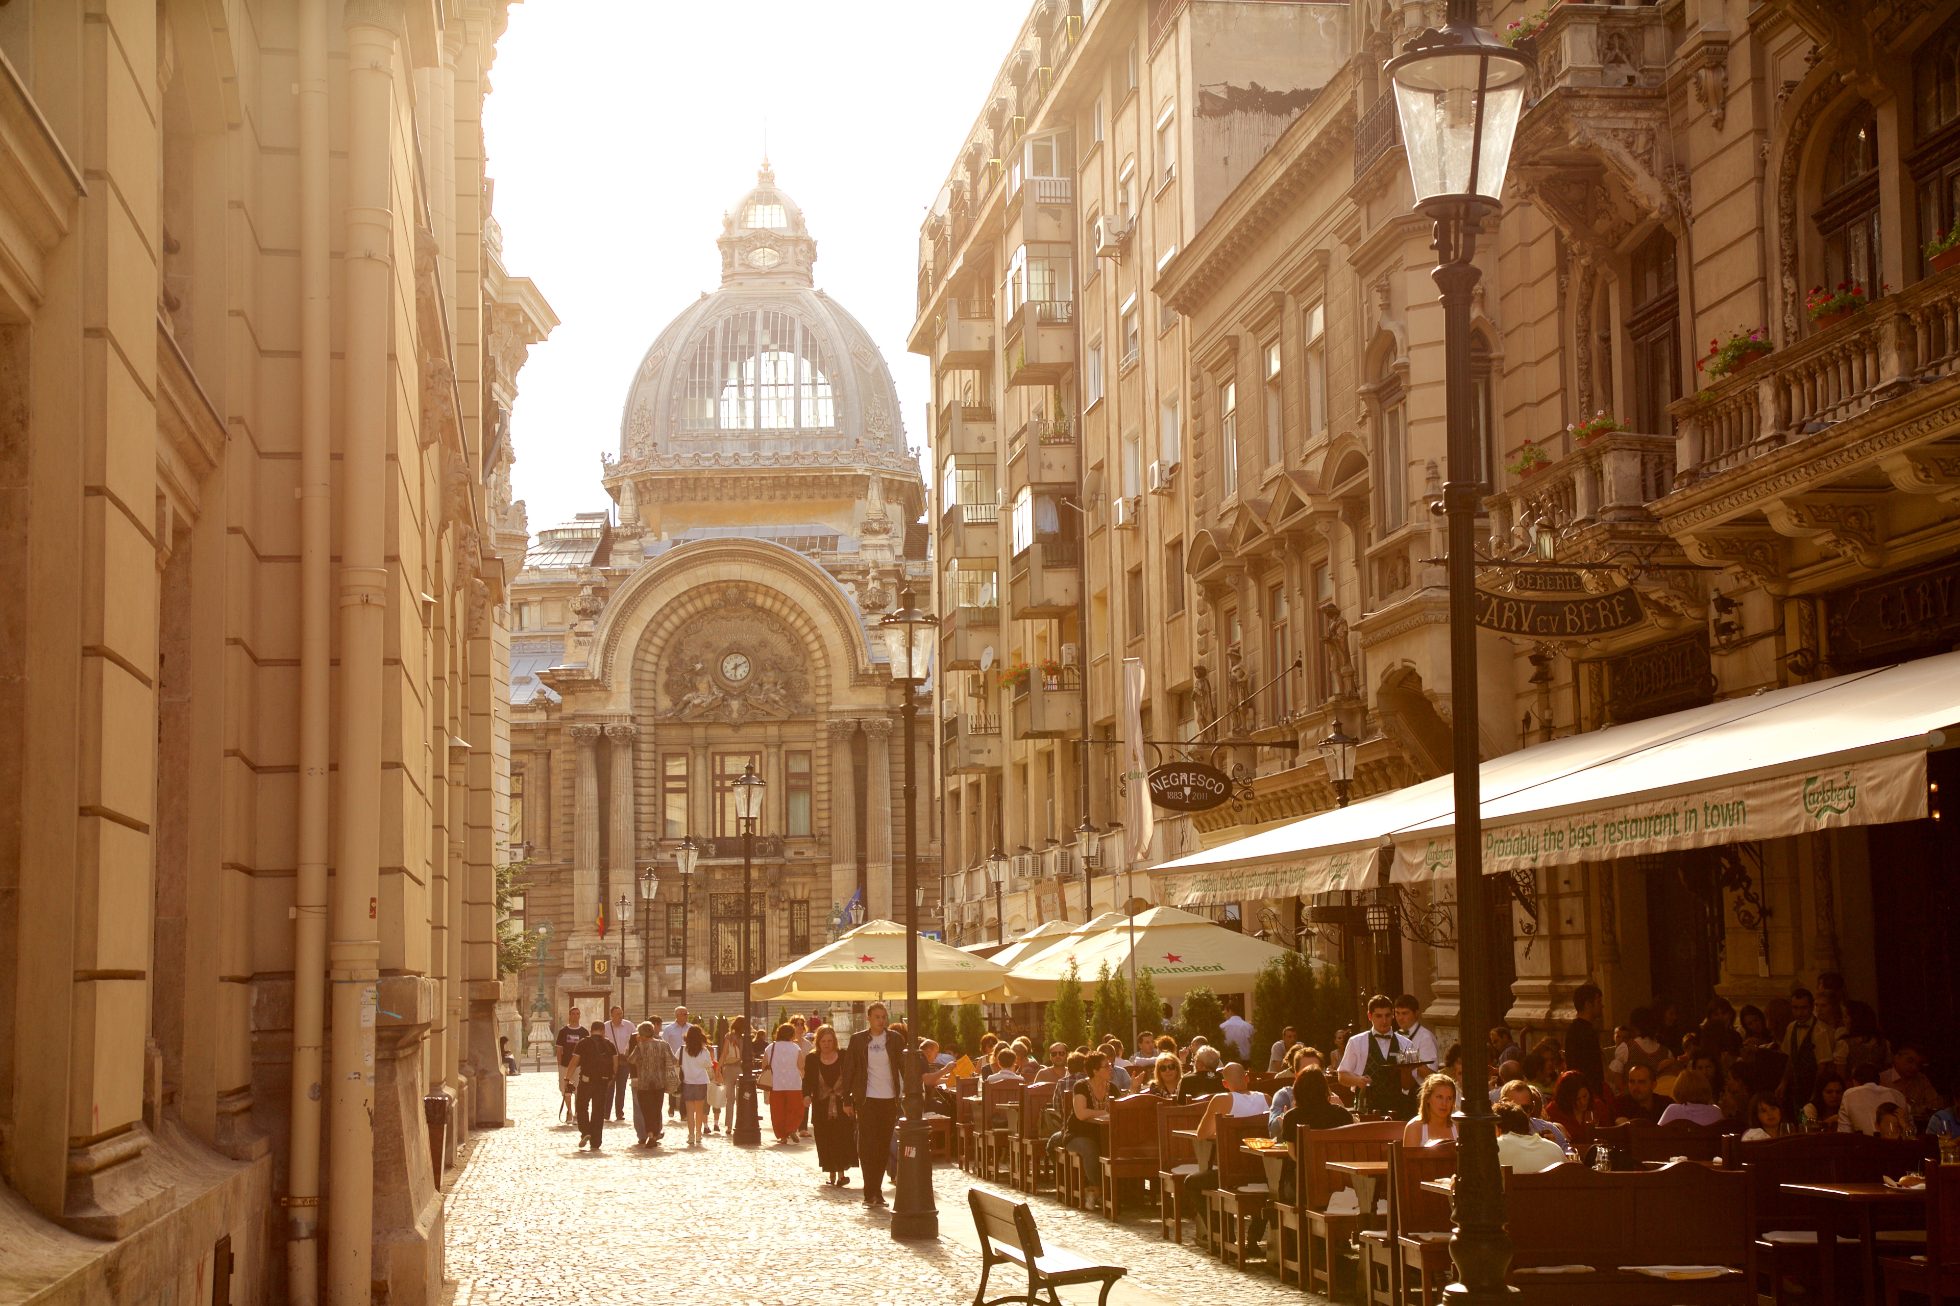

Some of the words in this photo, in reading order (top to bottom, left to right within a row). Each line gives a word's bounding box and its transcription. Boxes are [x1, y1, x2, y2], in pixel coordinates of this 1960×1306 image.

[1564, 596, 1631, 634] BERE
[1150, 772, 1225, 794] NEGRESCO
[1192, 792, 1208, 801] 2011
[1803, 771, 1857, 820] Carlsberg
[1486, 832, 1538, 862] Probably
[1543, 828, 1564, 851] the
[1568, 822, 1597, 848] best
[1603, 808, 1680, 845] restaurant
[1684, 802, 1698, 833] in
[1703, 800, 1747, 829] town
